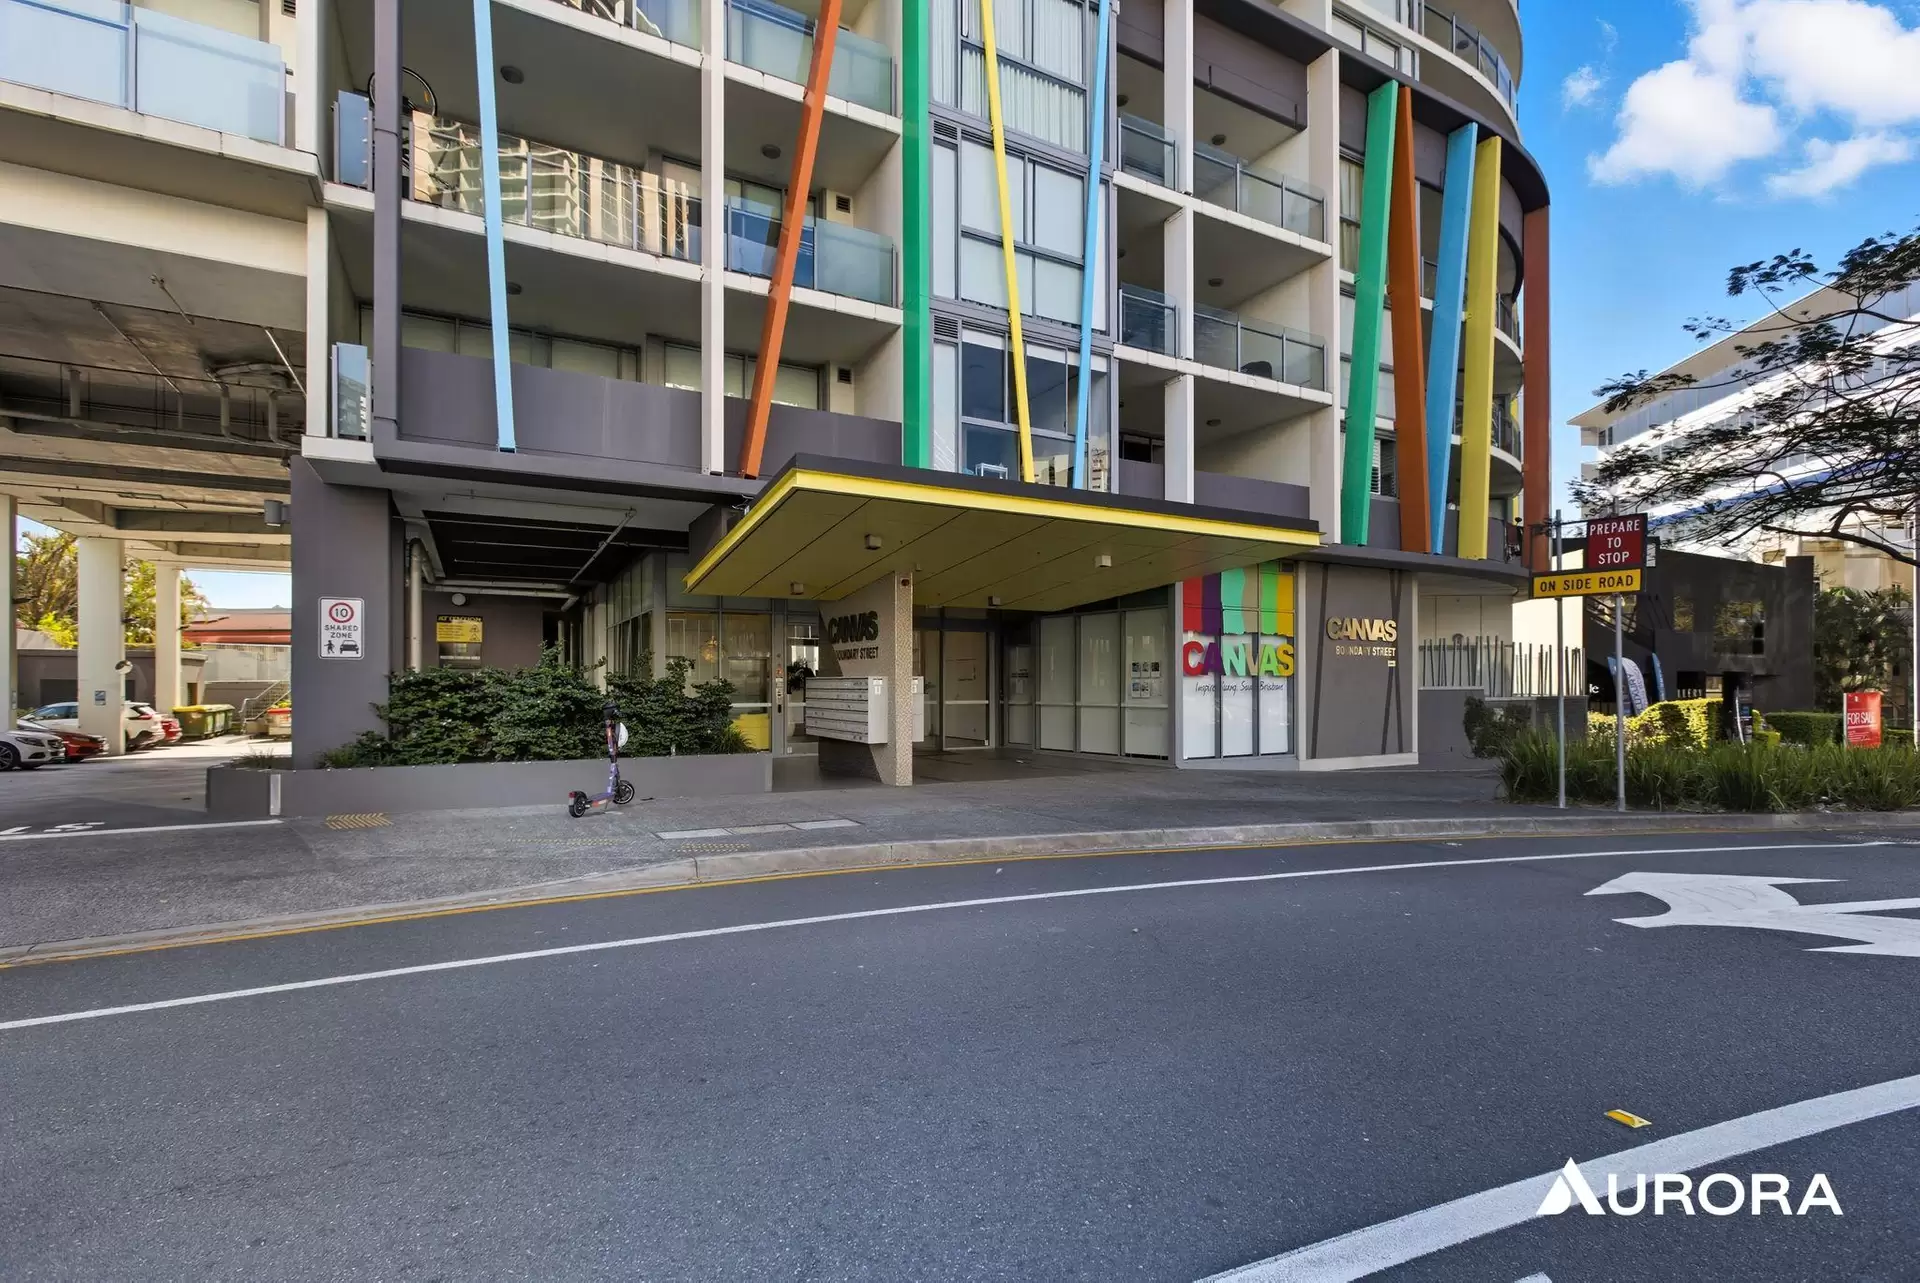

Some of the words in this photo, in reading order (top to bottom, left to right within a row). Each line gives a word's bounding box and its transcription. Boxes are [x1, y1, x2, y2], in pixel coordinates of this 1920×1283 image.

[1590, 520, 1640, 536] PREPARE
[1607, 537, 1622, 549] TO
[1598, 551, 1630, 565] STOP
[1540, 581, 1556, 592] ON
[1563, 578, 1592, 591] SIDE
[1599, 575, 1634, 588] ROAD
[335, 608, 349, 618] 10
[828, 611, 879, 644] CANVAS
[1327, 616, 1397, 642] CANVAS
[860, 647, 879, 660] STREET
[1335, 645, 1372, 657] BONDAY
[1372, 646, 1396, 657] STREET
[1183, 641, 1294, 677] CANVAS
[1847, 712, 1861, 724] FOR
